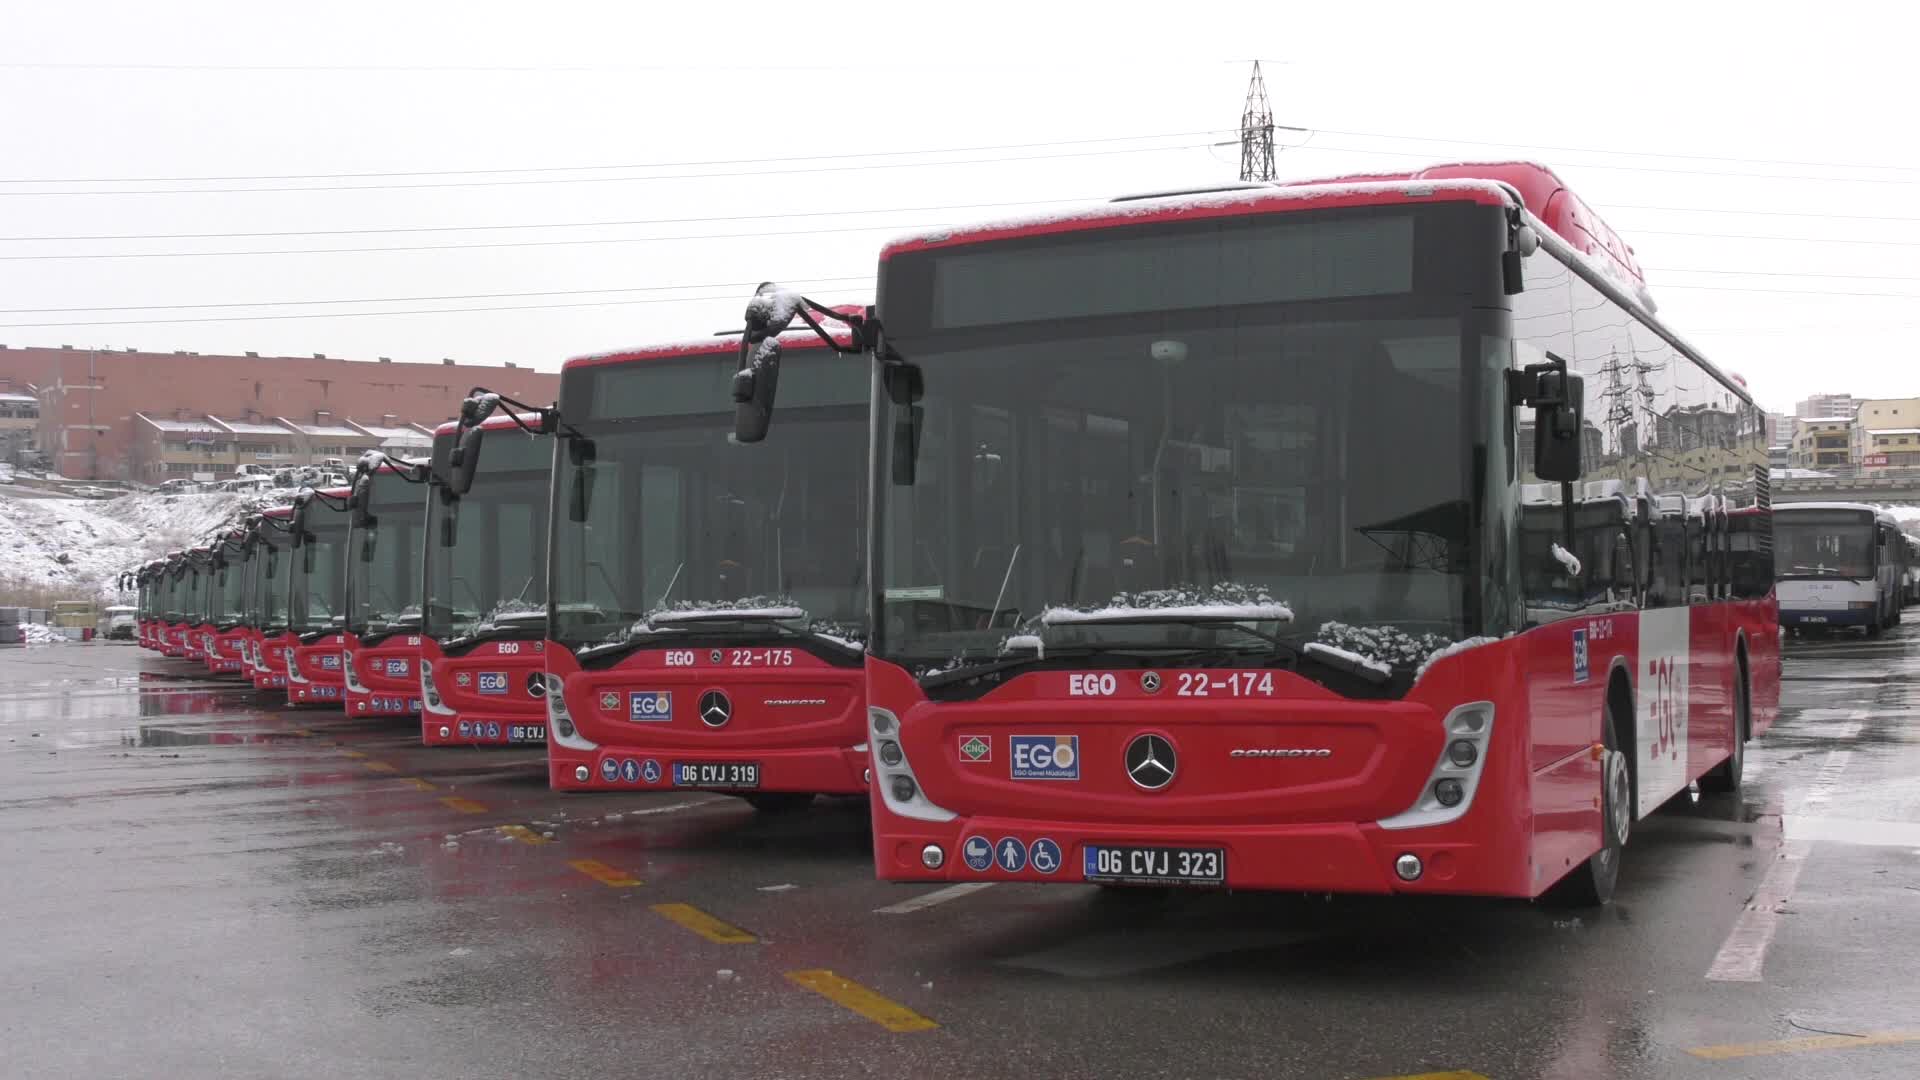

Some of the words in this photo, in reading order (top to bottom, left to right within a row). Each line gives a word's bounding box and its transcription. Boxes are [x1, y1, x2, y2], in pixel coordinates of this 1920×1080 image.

[498, 642, 519, 654] EGO
[323, 657, 341, 667] EGO
[665, 651, 694, 666] EGO
[731, 650, 793, 666] 22-175
[387, 662, 408, 673] EGO
[479, 676, 506, 689] EGO
[1069, 674, 1117, 696] EGO
[1177, 672, 1274, 698] 22-174
[632, 697, 669, 714] EGO
[513, 726, 525, 738] 06
[527, 726, 544, 739] CVJ
[965, 744, 985, 754] CNG
[1230, 749, 1332, 758] CONECTO
[1014, 744, 1075, 769] EGO
[682, 765, 698, 782] 06
[702, 765, 726, 782] CVJ
[730, 766, 756, 782] 319
[1097, 849, 1123, 874] 06
[1130, 850, 1169, 875] CVJ
[1177, 851, 1218, 877] 323
